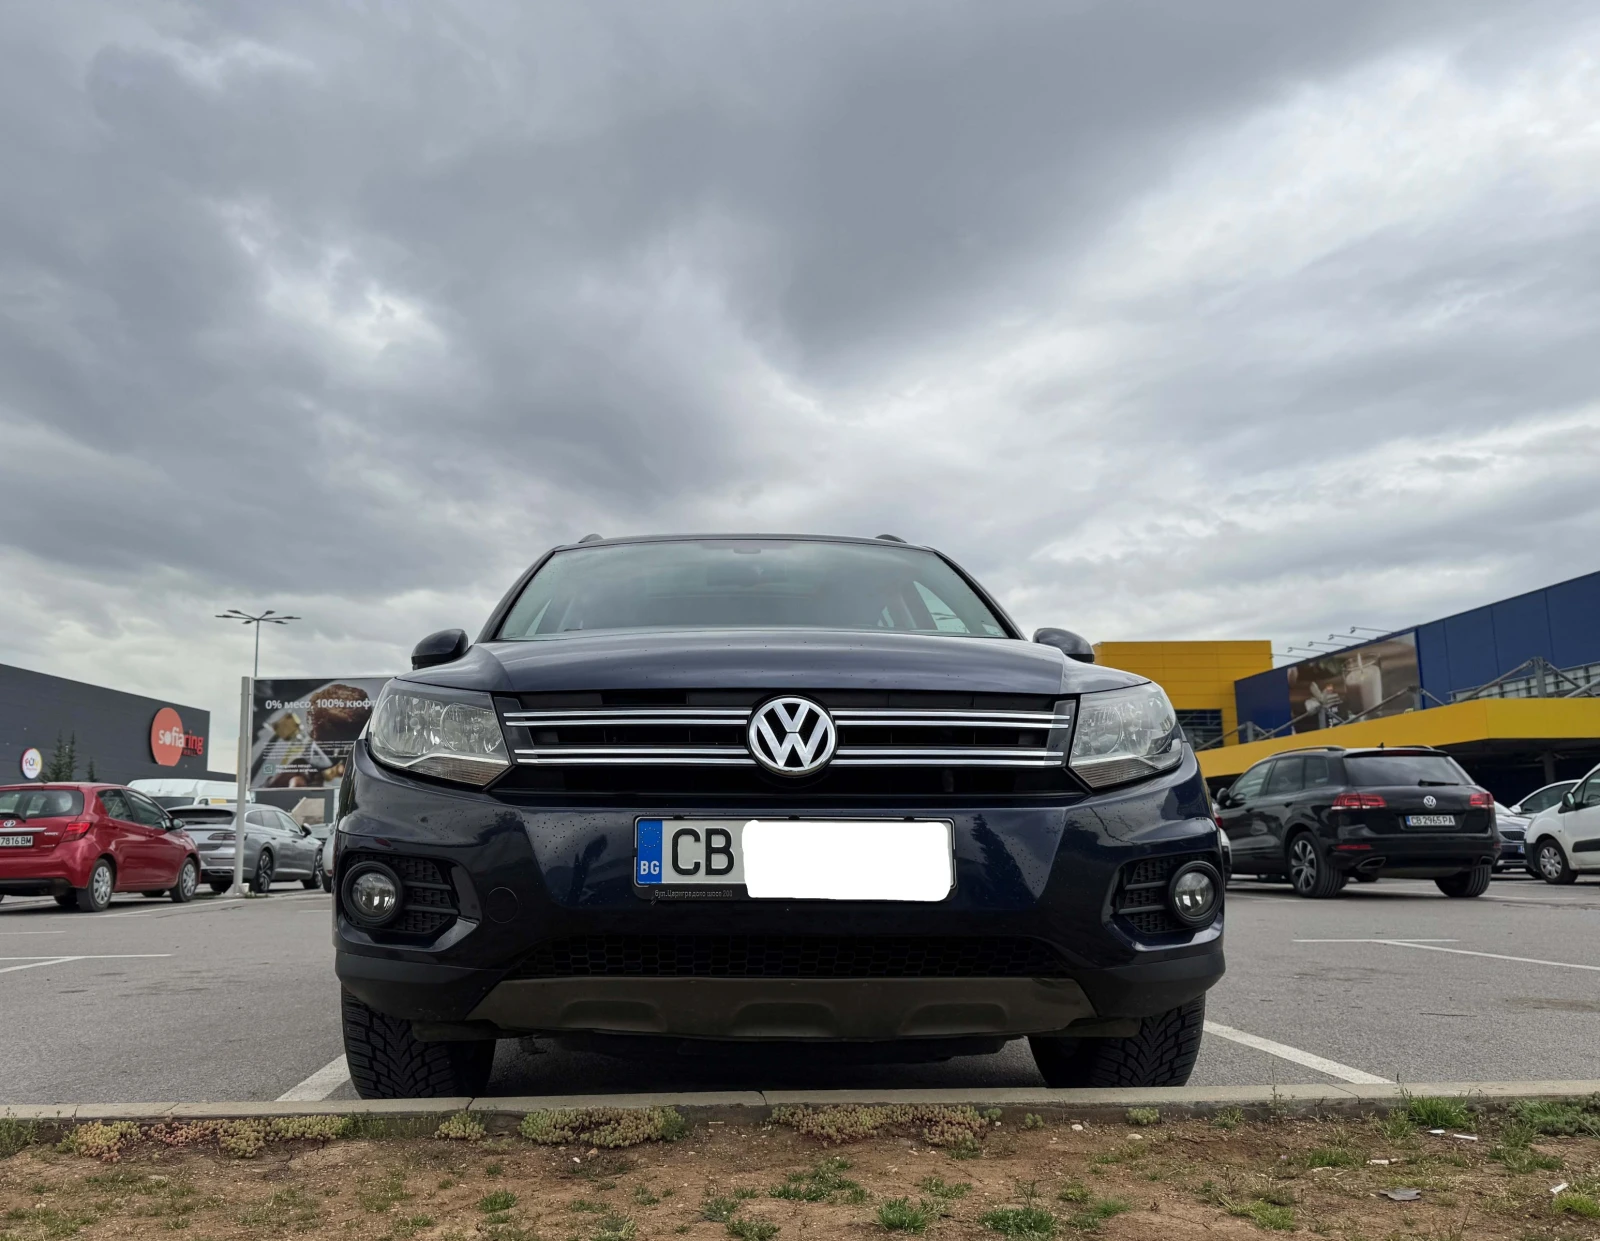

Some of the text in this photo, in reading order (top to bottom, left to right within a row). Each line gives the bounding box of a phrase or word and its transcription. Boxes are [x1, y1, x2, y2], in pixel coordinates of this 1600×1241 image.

[265, 700, 282, 709] 0%
[284, 701, 314, 710] месо,
[316, 699, 344, 708] 100%
[671, 828, 735, 875] CB
[640, 860, 660, 875] BG
